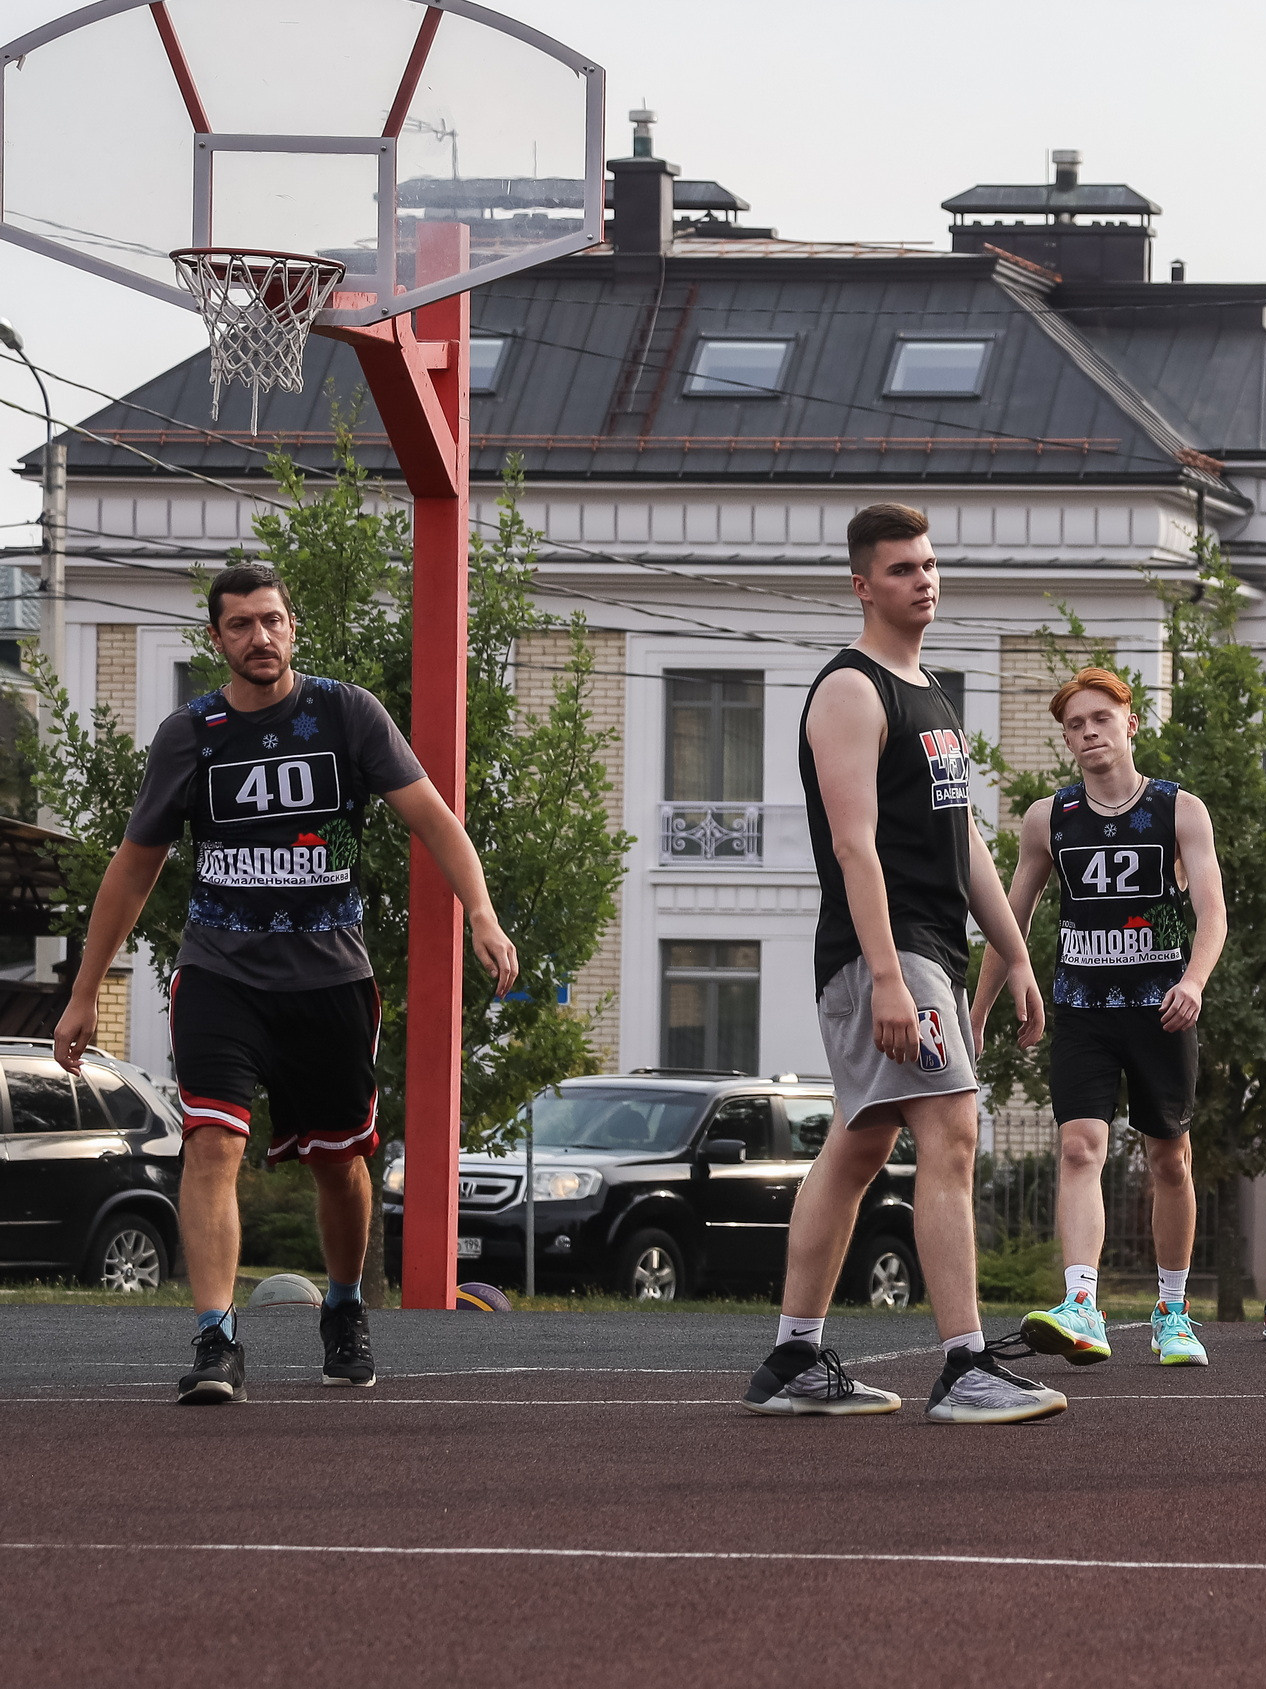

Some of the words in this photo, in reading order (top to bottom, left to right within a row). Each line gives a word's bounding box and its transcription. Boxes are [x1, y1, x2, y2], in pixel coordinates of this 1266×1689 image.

[235, 760, 315, 812] 40
[231, 876, 306, 886] маленькая
[310, 872, 349, 884] Москва
[1081, 850, 1140, 893] 42
[1081, 955, 1135, 965] мленькая
[1138, 951, 1180, 962] Москва
